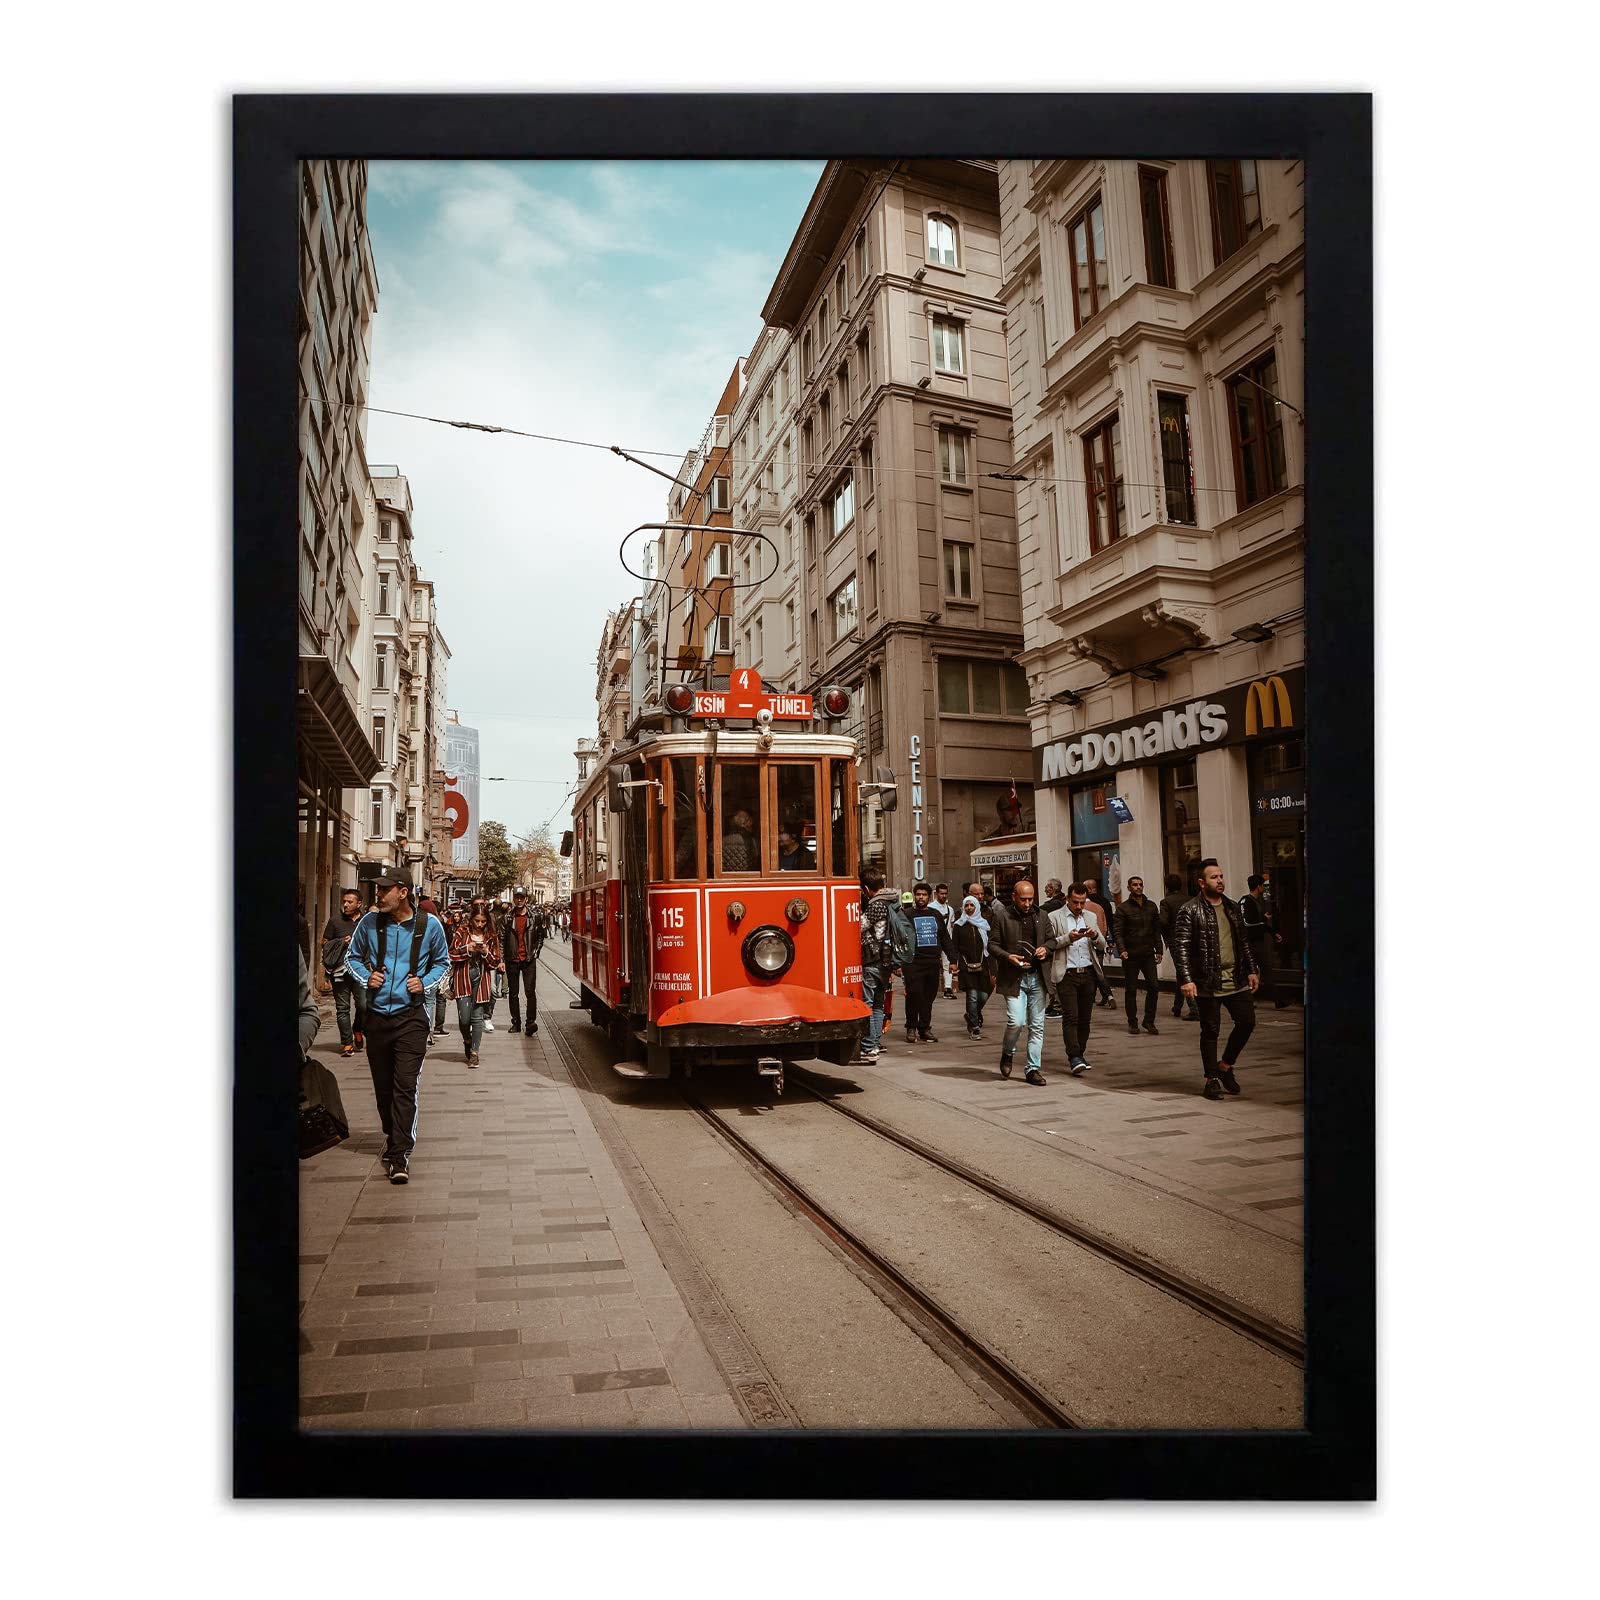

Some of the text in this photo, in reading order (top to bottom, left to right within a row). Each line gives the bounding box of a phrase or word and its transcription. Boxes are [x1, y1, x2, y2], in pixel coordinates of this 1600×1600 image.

[739, 670, 749, 689] 4
[768, 696, 811, 716] TÜNEL
[1041, 701, 1229, 782] McDonald's
[910, 735, 925, 880] CENTRO
[1270, 796, 1292, 810] 03:00
[991, 854, 1013, 863] GAZETE
[661, 907, 684, 929] 115
[845, 902, 860, 923] 115
